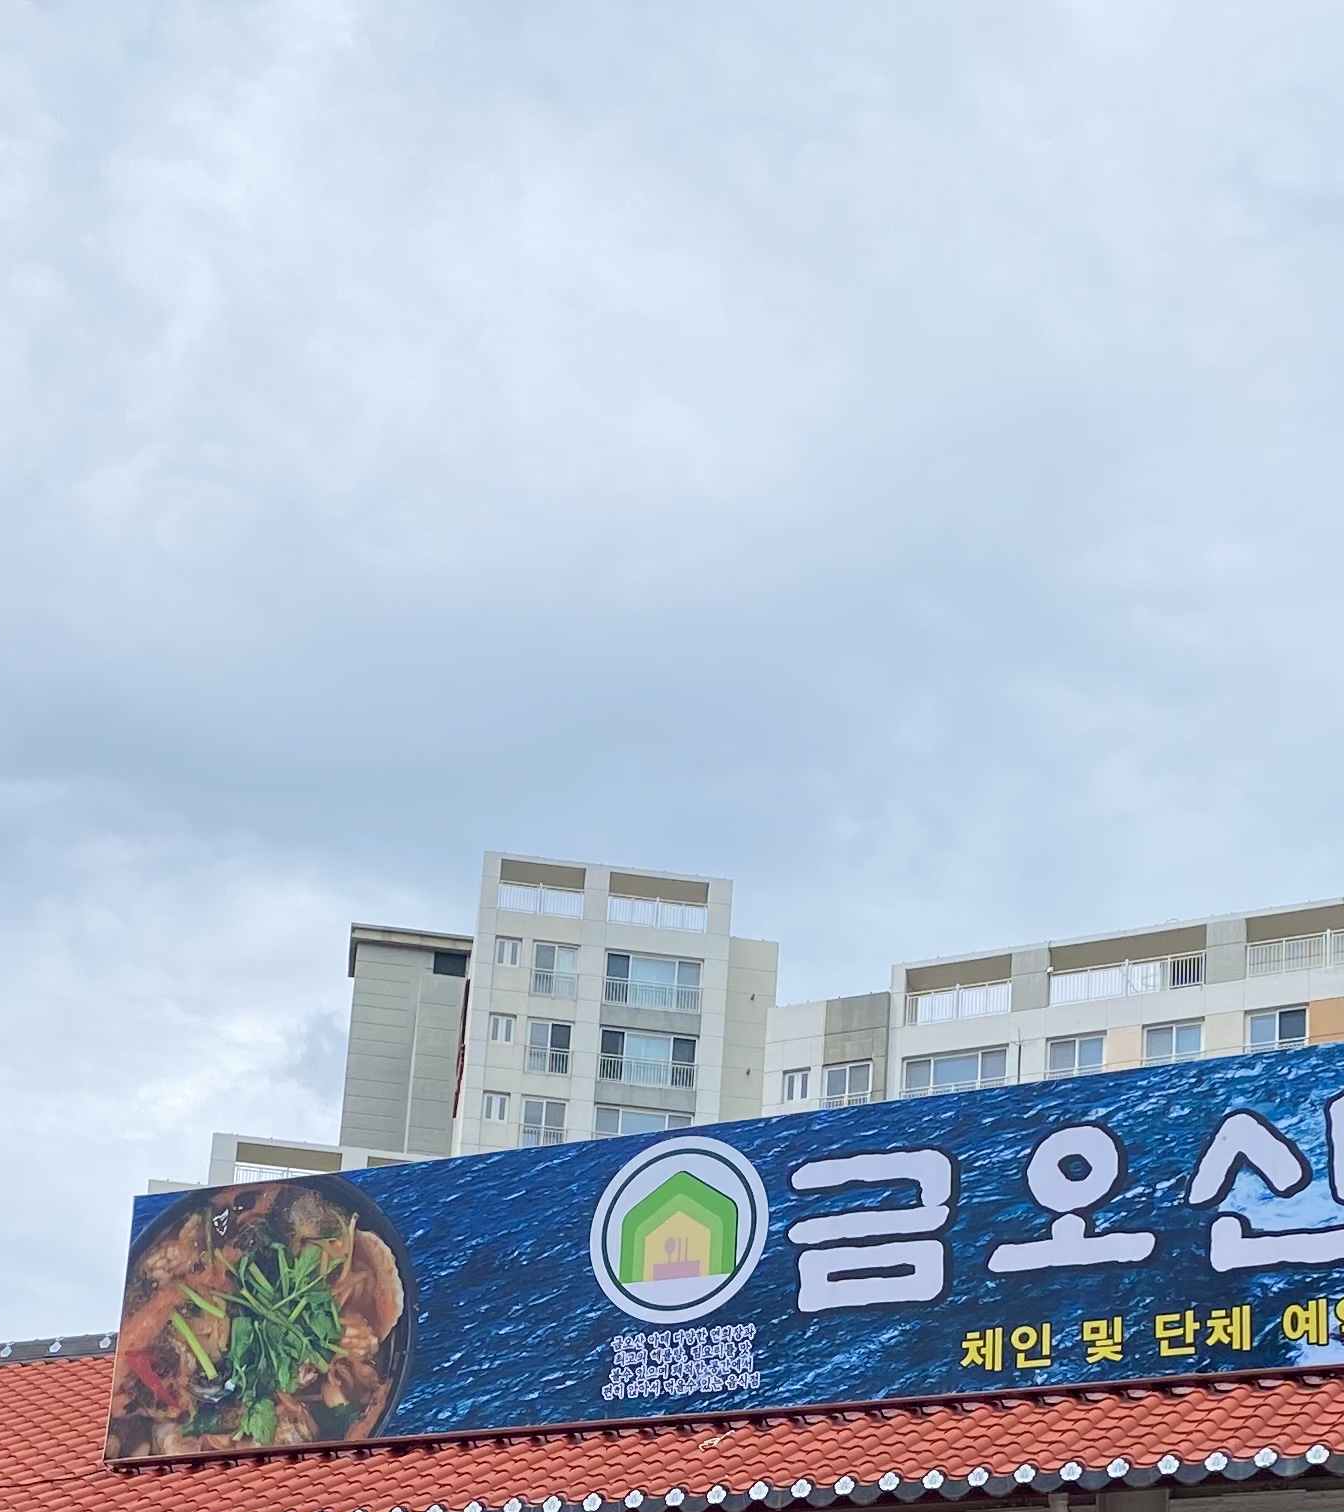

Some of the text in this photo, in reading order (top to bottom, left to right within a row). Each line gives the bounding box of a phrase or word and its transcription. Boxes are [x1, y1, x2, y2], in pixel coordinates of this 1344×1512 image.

[611, 1333, 646, 1350] 금오산
[672, 1327, 708, 1345] 다양한
[710, 1323, 756, 1343] 연회장과
[960, 1326, 1052, 1372] 체인
[1082, 1316, 1124, 1364] 및
[1154, 1304, 1252, 1357] 단체
[614, 1349, 648, 1366] 최고의
[635, 1364, 669, 1381] 있으며
[708, 1356, 753, 1374] 공간에서
[700, 1376, 723, 1393] 있는
[725, 1371, 760, 1392] 음식점
